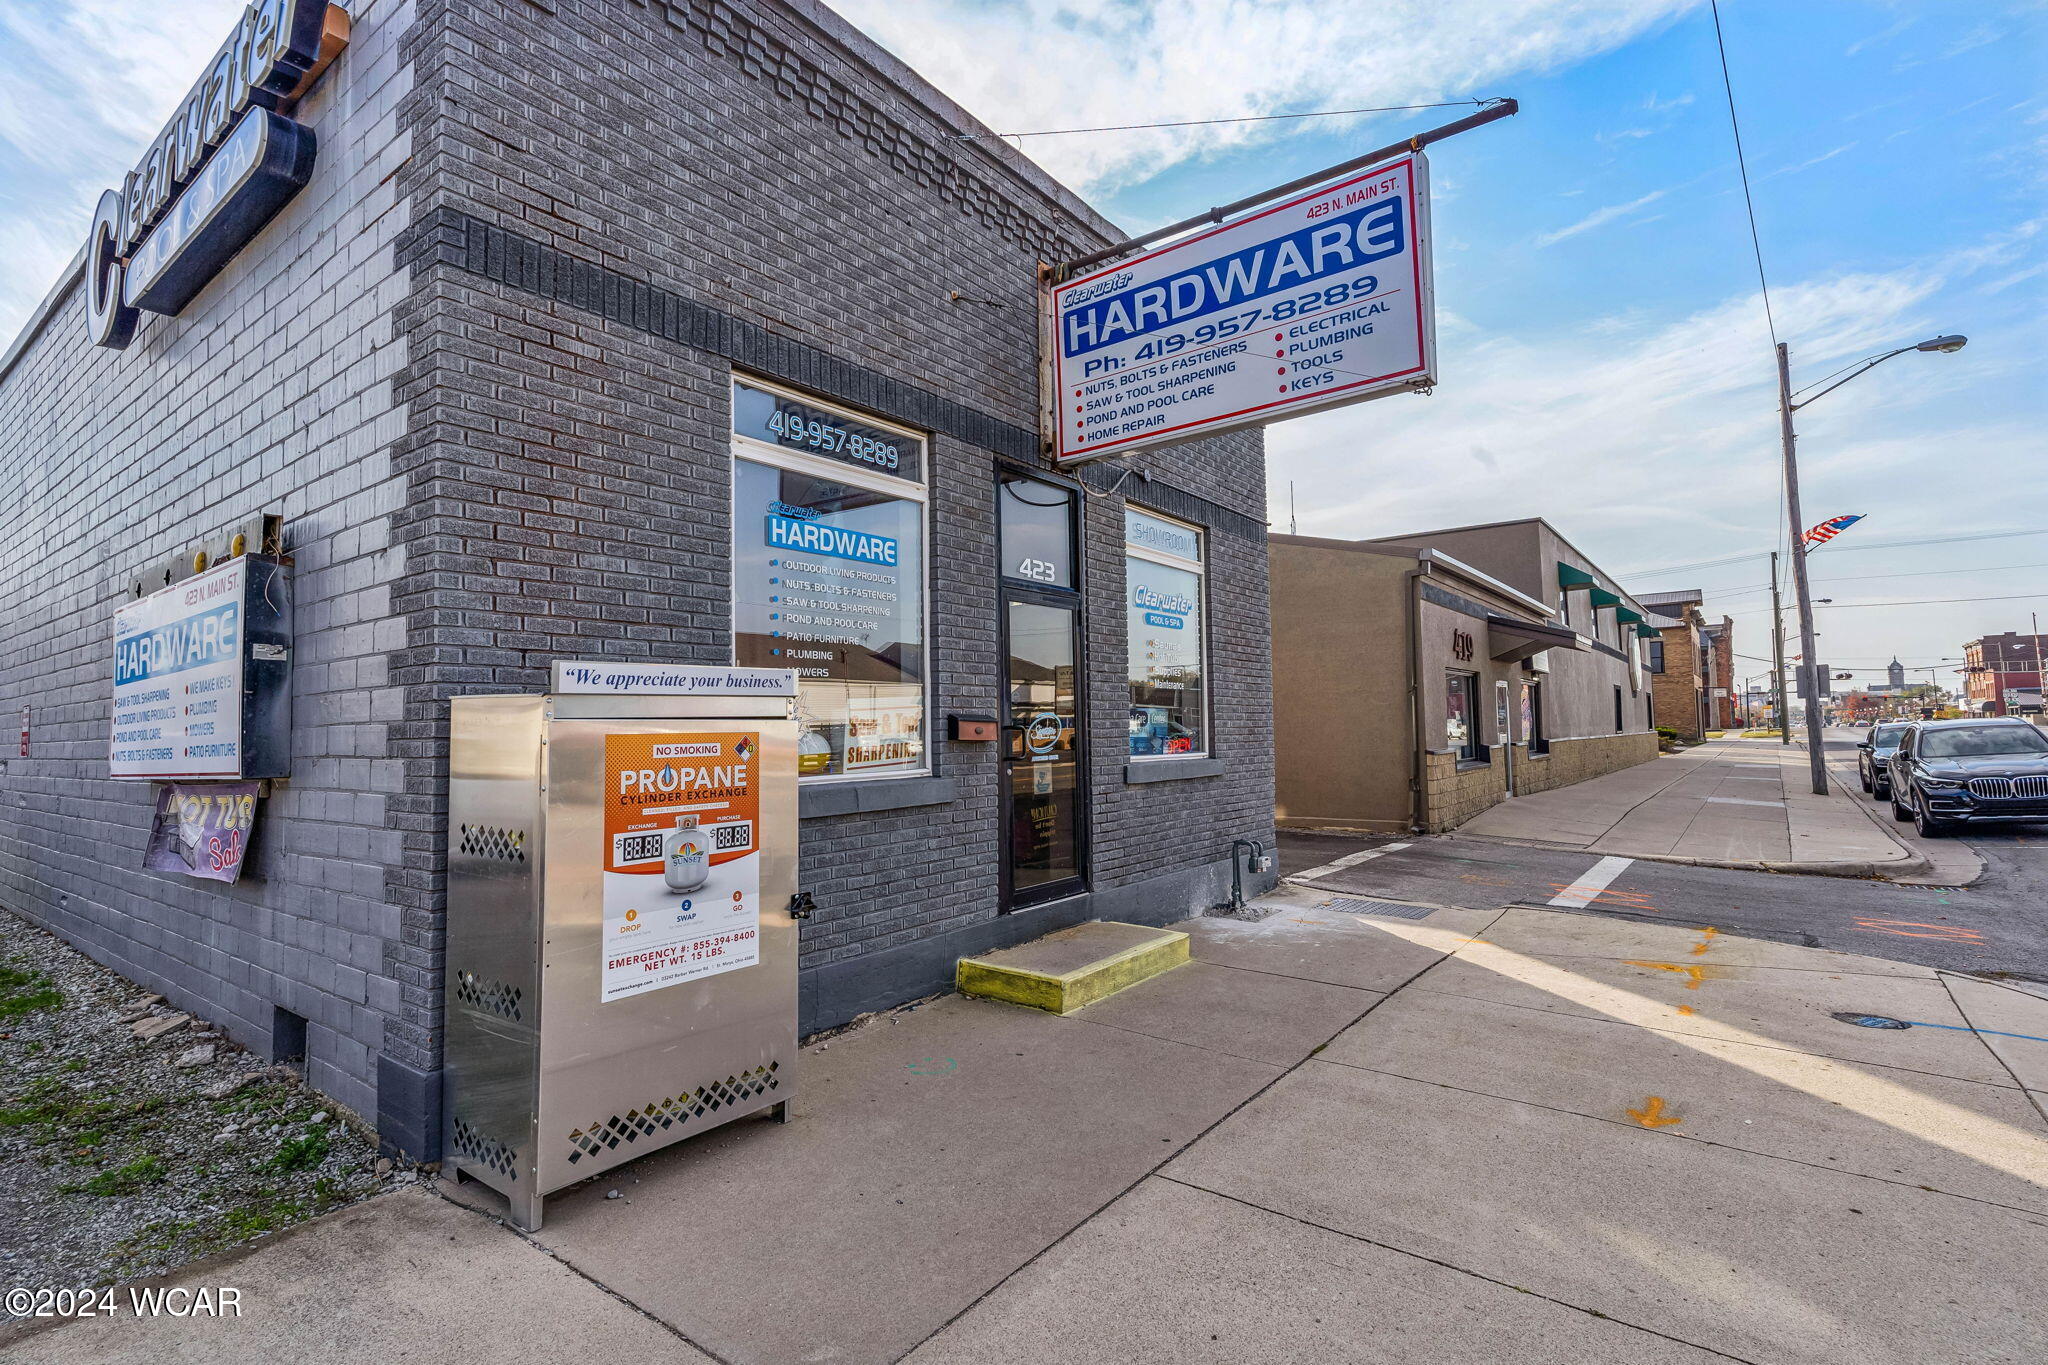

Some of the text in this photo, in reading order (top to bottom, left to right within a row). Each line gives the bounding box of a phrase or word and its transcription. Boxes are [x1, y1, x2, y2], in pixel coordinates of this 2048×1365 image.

[205, 137, 247, 209] SPA
[1306, 177, 1400, 219] 423 N. MAIN ST.
[1069, 205, 1395, 352] HARDWARE
[1062, 272, 1134, 308] Clearwater
[1084, 276, 1378, 378] Ph: 419-957-8289
[1289, 301, 1390, 338] ELECTRICAL
[1289, 322, 1374, 356] PLUMBING
[1086, 340, 1248, 396] NUTS, BOLTS & FASTENERS
[1291, 350, 1344, 373] TOOLS
[1086, 361, 1236, 411] SAW & TOOL SHARPENING
[1291, 371, 1334, 392] KEYS
[1086, 384, 1215, 426] POND AND POOL CARE
[1088, 414, 1165, 442] HOME REPAIR
[769, 410, 899, 469] 419-957-8289
[772, 517, 896, 564] HARDWARE
[1134, 522, 1192, 553] SHOWROOM
[786, 560, 897, 585] OUTDOOR LIVING PRODUCTS
[1019, 558, 1055, 582] 423
[184, 588, 198, 606] 423
[206, 578, 226, 600] MAIN
[815, 584, 842, 595] BOLTS
[852, 588, 897, 602] FASTENERS
[1136, 584, 1193, 616] Clearwater
[786, 596, 891, 616] SAW & TOOL SHARPENING
[786, 614, 878, 631] POND AND POOL CARE
[1150, 616, 1181, 628] POOL & SPA
[116, 608, 235, 681] HARDWARE
[786, 632, 860, 646] PATIO FURNITURE
[1453, 628, 1473, 662] 419
[786, 649, 833, 661] PLUMBING
[605, 671, 687, 690] appreciate
[688, 675, 723, 691] your
[788, 668, 829, 678] OWERS
[1154, 667, 1182, 678] Supplies
[190, 681, 199, 694] WE
[200, 677, 215, 693] MAKE
[1154, 679, 1184, 690] Maintenance
[118, 697, 126, 708] SAW
[130, 694, 141, 706] TOOL
[141, 688, 170, 704] SHARPENING
[190, 700, 217, 716] PLUMBING
[116, 706, 176, 726] OUTDOOR LIVING PRODUCTS
[116, 728, 162, 744] POND AND POOL CARE
[190, 722, 214, 737] MOWERS
[127, 749, 142, 762] BOLTS
[146, 747, 173, 760] FASTENERS
[190, 742, 236, 759] PATIO FURNITURE
[656, 745, 718, 756] NO SMOKING
[1167, 737, 1191, 754] OPEN
[620, 764, 747, 794] PROPANE
[620, 788, 748, 806] CYLINDER EXCHANGE
[628, 822, 658, 830] EXCHANGE
[716, 814, 741, 822] PURCHASE
[673, 856, 702, 867] SUNSET
[676, 912, 697, 922] SWAP
[732, 904, 743, 912] GO
[620, 924, 642, 934] DROP
[608, 946, 680, 970] EMERGENCY
[693, 930, 756, 950] 855-394-8400
[644, 947, 726, 972] NET WT. 15 LBS.
[608, 980, 654, 994] sunsetexchange.com
